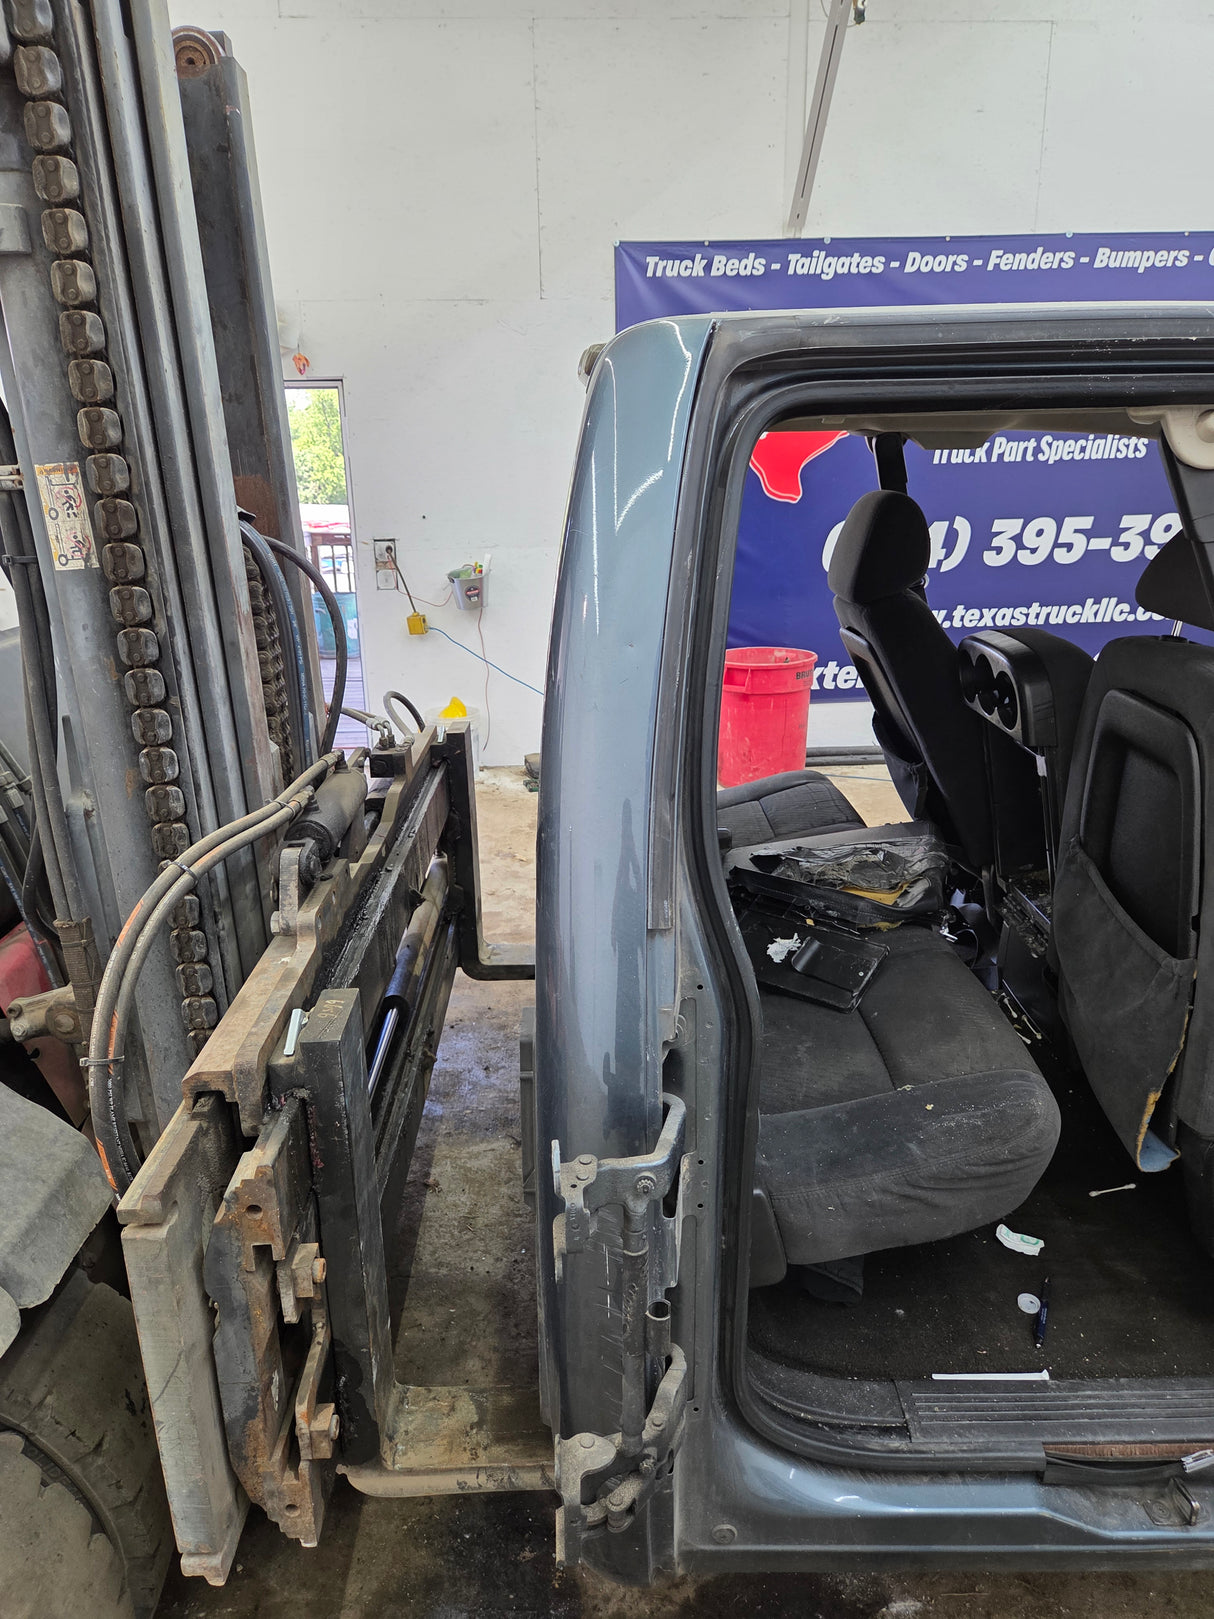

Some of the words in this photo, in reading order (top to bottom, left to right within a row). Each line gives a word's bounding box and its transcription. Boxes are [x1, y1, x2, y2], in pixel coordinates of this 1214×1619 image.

[645, 253, 708, 278] Truck
[710, 252, 767, 277] Beds
[787, 250, 886, 281] Tailgates
[903, 251, 969, 273] Doors
[986, 246, 1076, 271] Fenders
[1093, 247, 1190, 274] Bumpers
[991, 436, 1037, 463] Part
[1037, 433, 1149, 465] Specialists
[982, 512, 1184, 567] 395-39
